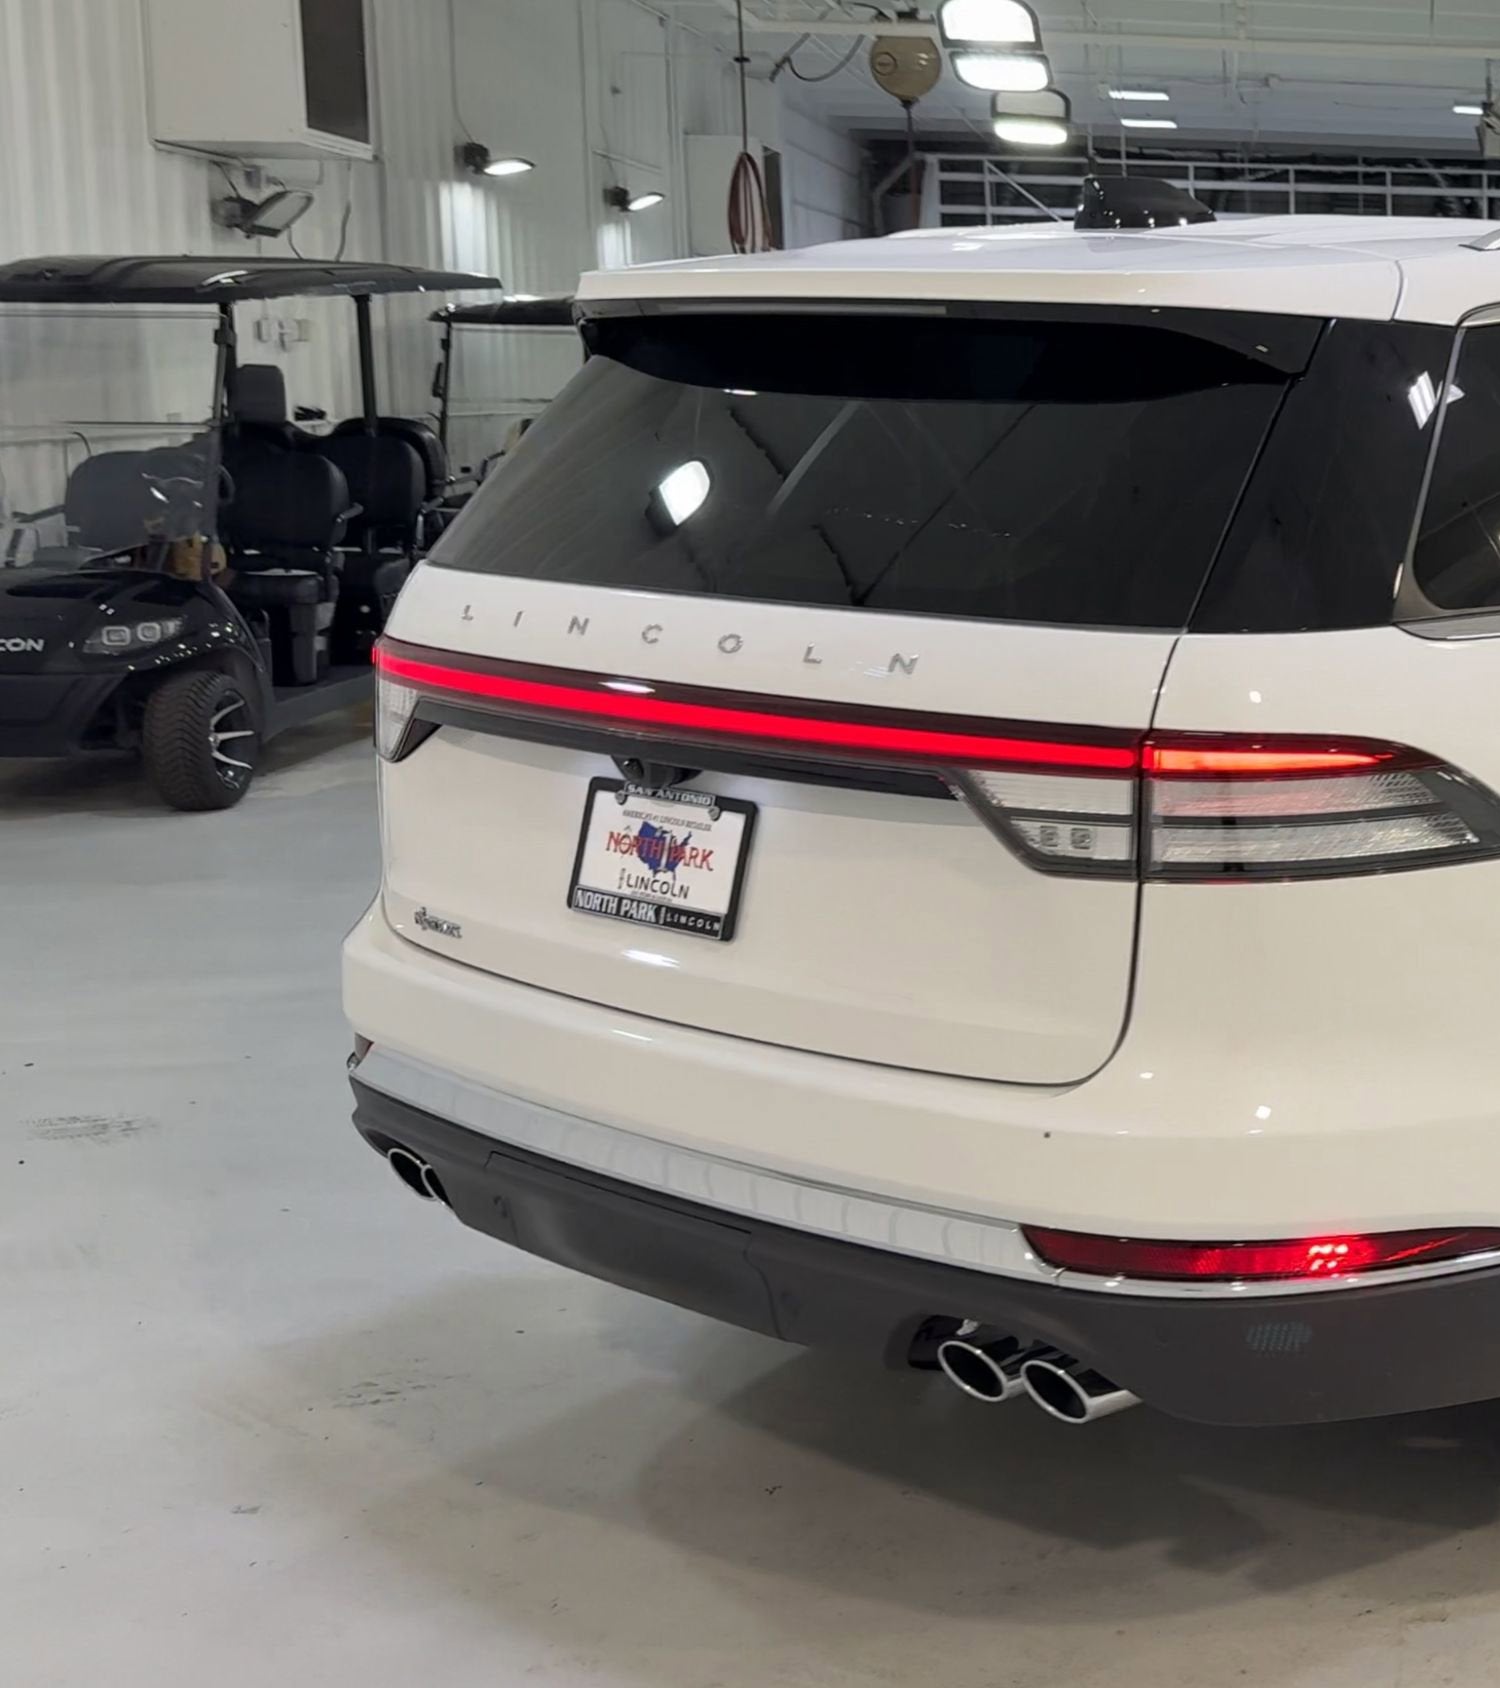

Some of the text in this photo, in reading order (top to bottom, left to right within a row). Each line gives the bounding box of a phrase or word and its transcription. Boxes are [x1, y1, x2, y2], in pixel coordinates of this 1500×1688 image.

[461, 604, 919, 675] LINCOLN
[655, 789, 711, 805] ANTONIO
[606, 831, 713, 871] NORTH PARK
[626, 873, 690, 899] LINCOLN
[574, 889, 620, 915] NORTH
[620, 899, 657, 923] PARK
[665, 912, 721, 931] LINCOLN
